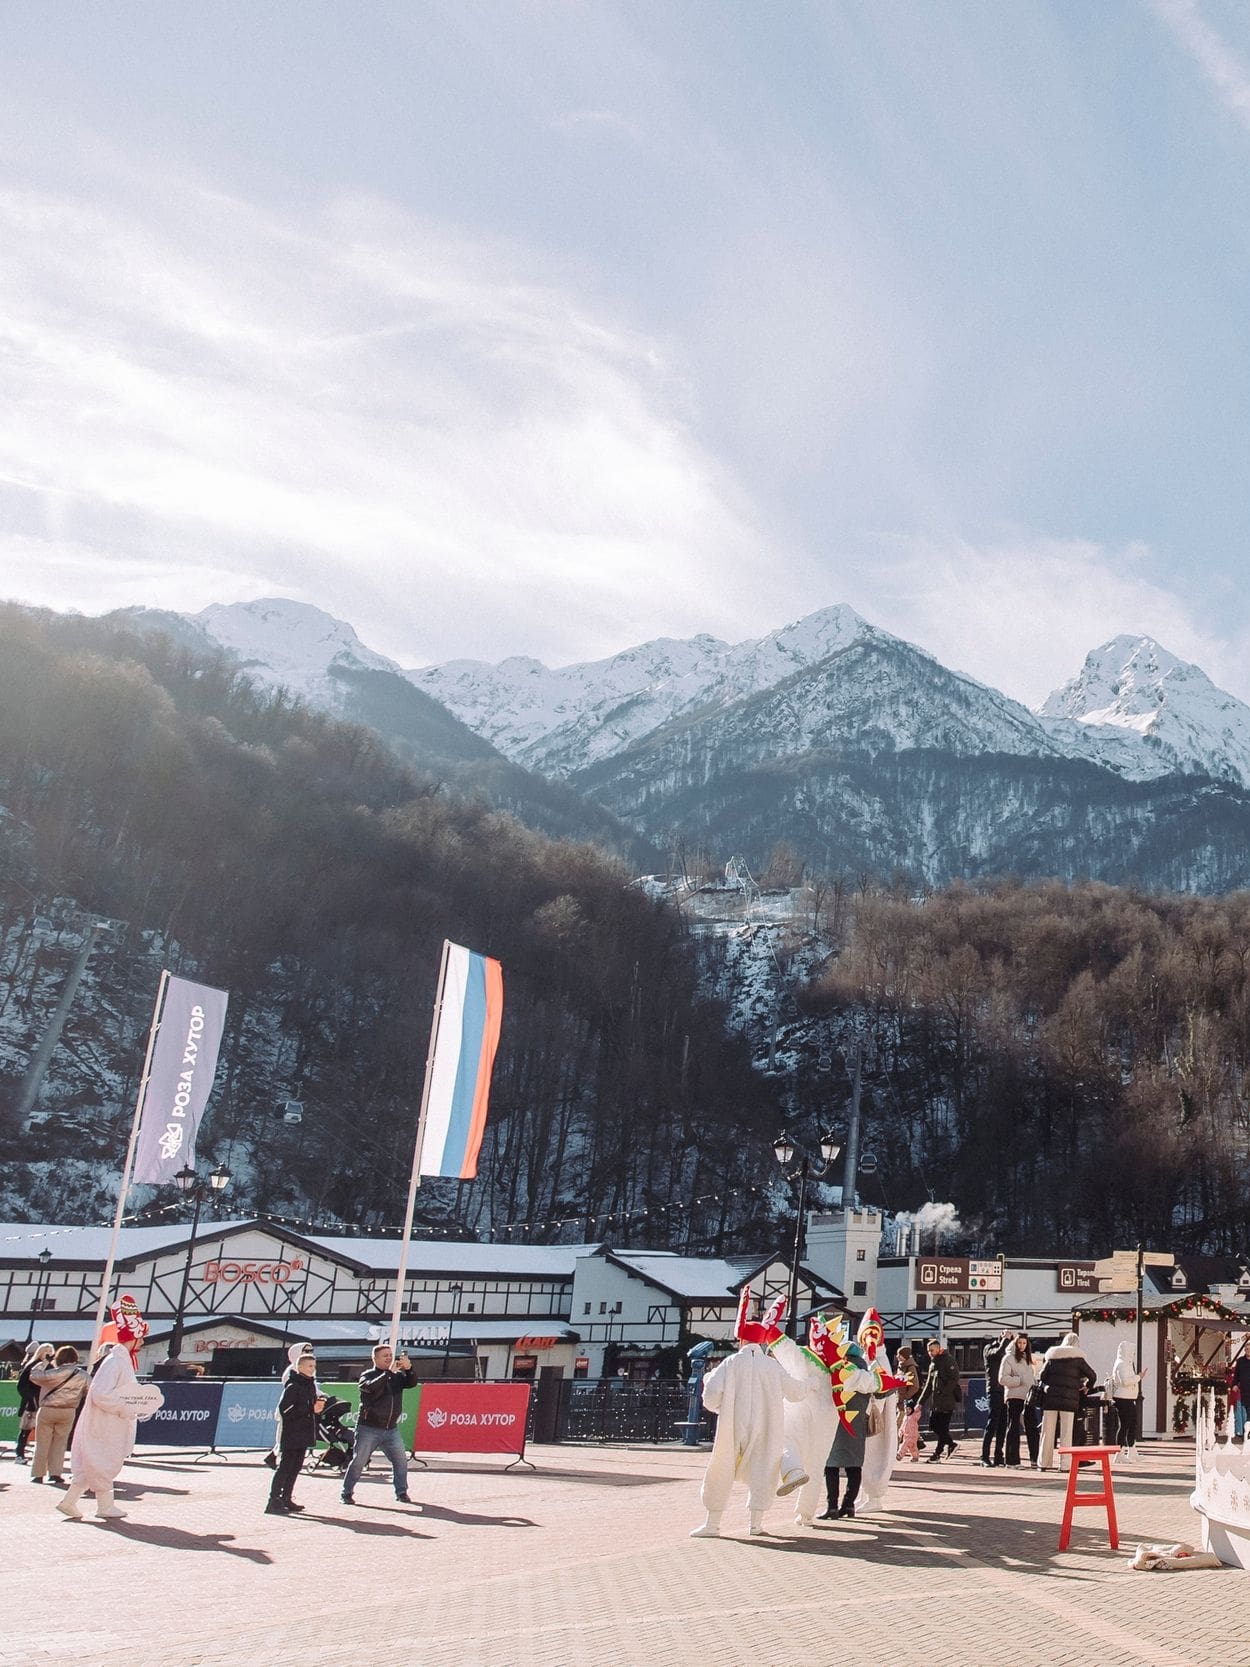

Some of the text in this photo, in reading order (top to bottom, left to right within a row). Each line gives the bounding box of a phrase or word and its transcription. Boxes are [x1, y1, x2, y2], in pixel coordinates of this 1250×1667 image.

[172, 1005, 205, 1118] РОЗА ХУТОР
[203, 1261, 291, 1284] BOSCO
[939, 1264, 962, 1274] Стрела
[939, 1275, 958, 1284] Strela
[0, 1407, 17, 1417] ТОР
[155, 1410, 210, 1421] РОЗА ХУТОР
[247, 1409, 275, 1420] РОЗА
[450, 1413, 516, 1426] РОЗА ХУТОР
